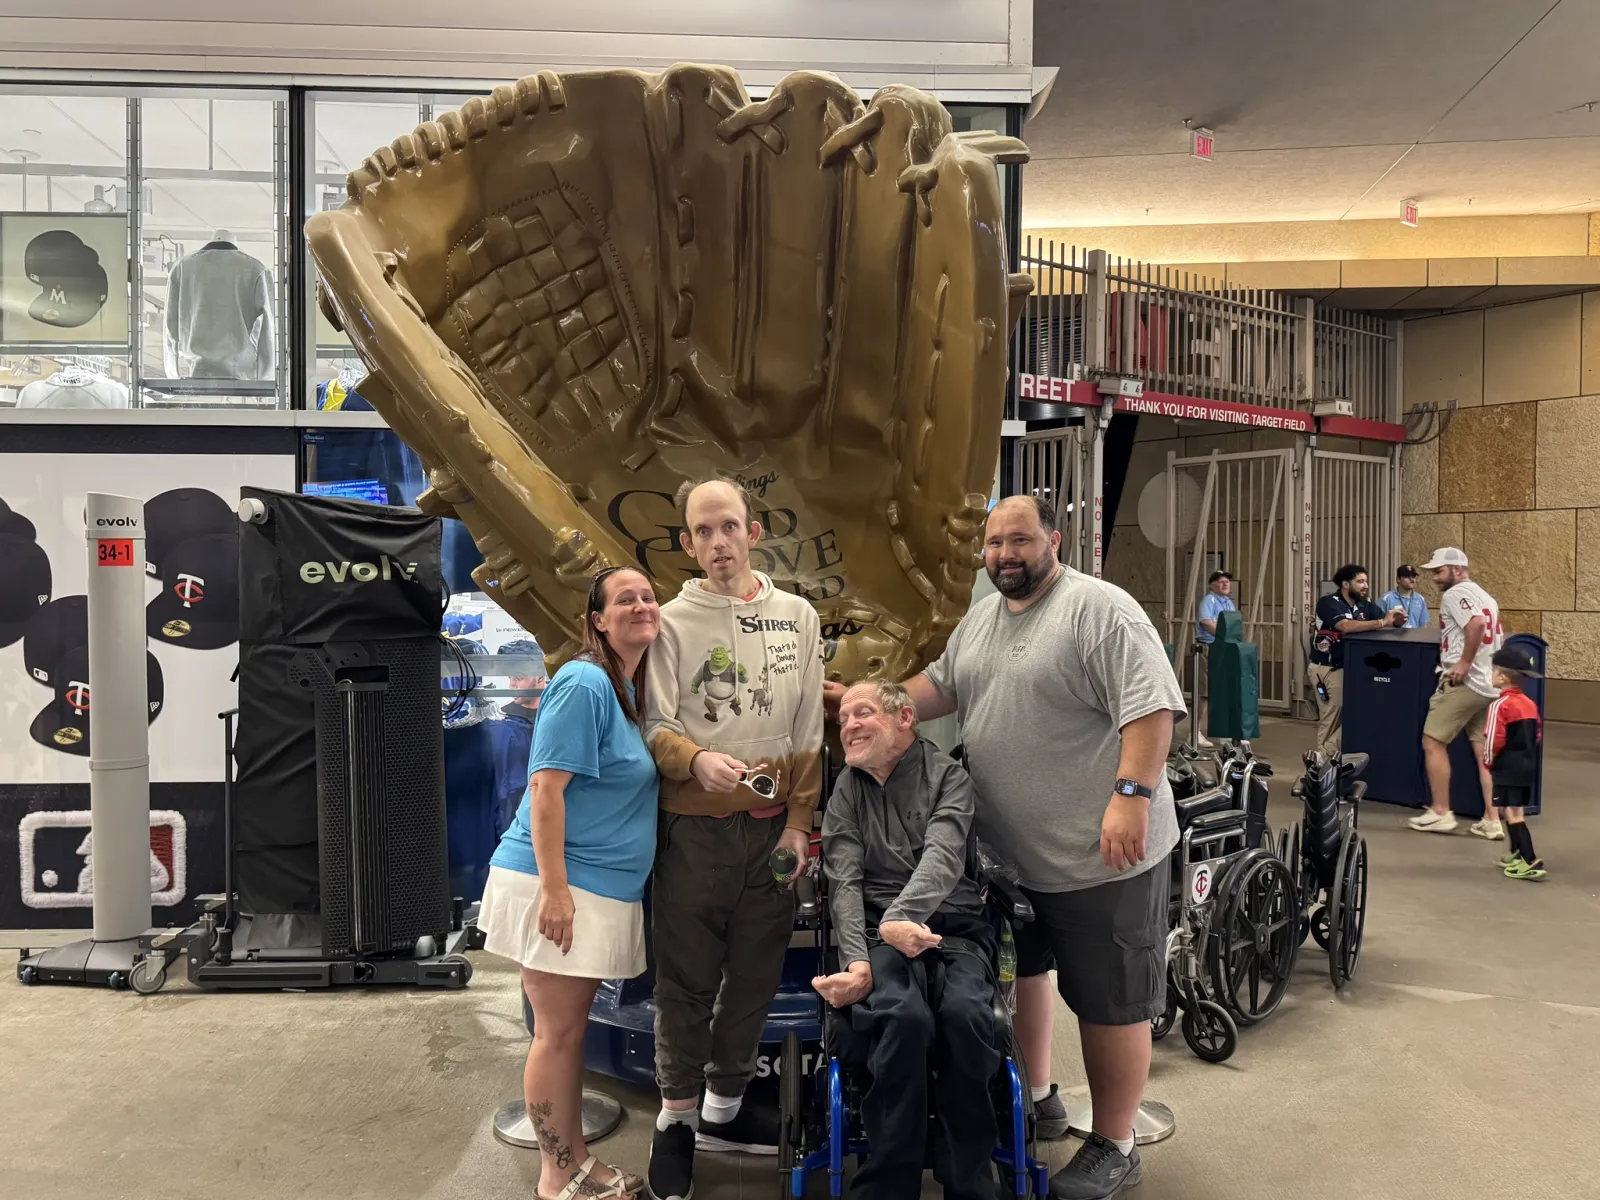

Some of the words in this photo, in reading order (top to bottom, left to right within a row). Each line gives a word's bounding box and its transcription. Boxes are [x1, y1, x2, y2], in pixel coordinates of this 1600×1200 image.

[1196, 135, 1213, 157] EXIT
[49, 288, 66, 304] M
[1019, 373, 1075, 402] REET
[1124, 398, 1161, 415] THANK
[1163, 403, 1184, 417] YOU
[1186, 405, 1206, 419] FOR
[1210, 408, 1249, 425] VISITING
[1251, 414, 1282, 429] TARGET
[1284, 418, 1306, 431] FIELD
[1094, 496, 1102, 520] NO
[1305, 502, 1311, 523] NO
[96, 516, 139, 527] evolv
[98, 544, 131, 561] 34-1
[300, 555, 418, 584] evolv
